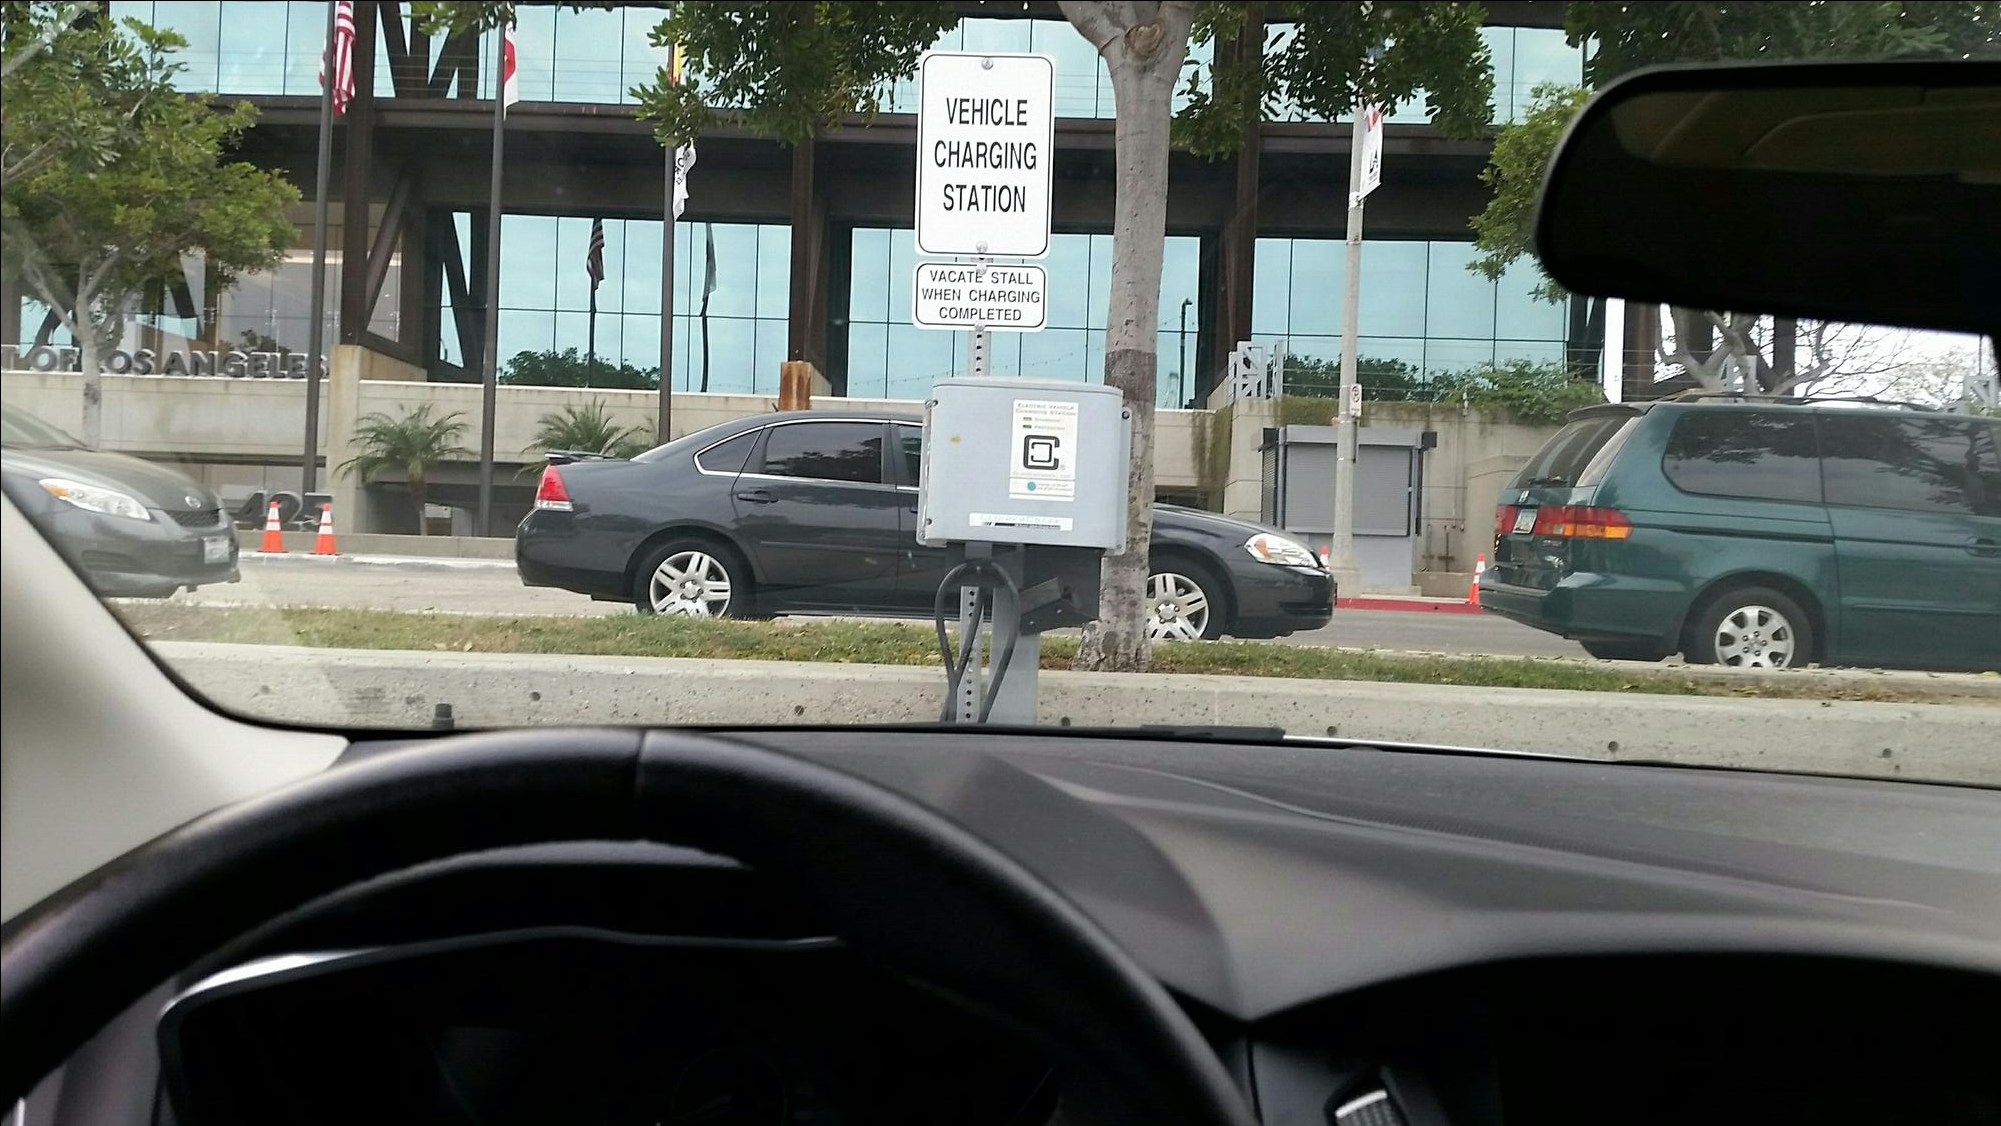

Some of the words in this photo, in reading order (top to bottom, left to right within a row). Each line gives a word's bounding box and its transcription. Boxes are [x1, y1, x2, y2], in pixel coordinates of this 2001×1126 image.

[946, 97, 1028, 126] VEHICLE
[934, 140, 1037, 170] CHARGING
[943, 183, 1026, 213] STATION
[929, 270, 984, 283] VACATE
[990, 271, 1034, 285] STALL
[921, 288, 961, 301] WHEN
[968, 289, 1041, 304] CHARGING
[939, 306, 1022, 321] COMPLETED
[33, 345, 79, 372] OF
[100, 349, 156, 376] OS
